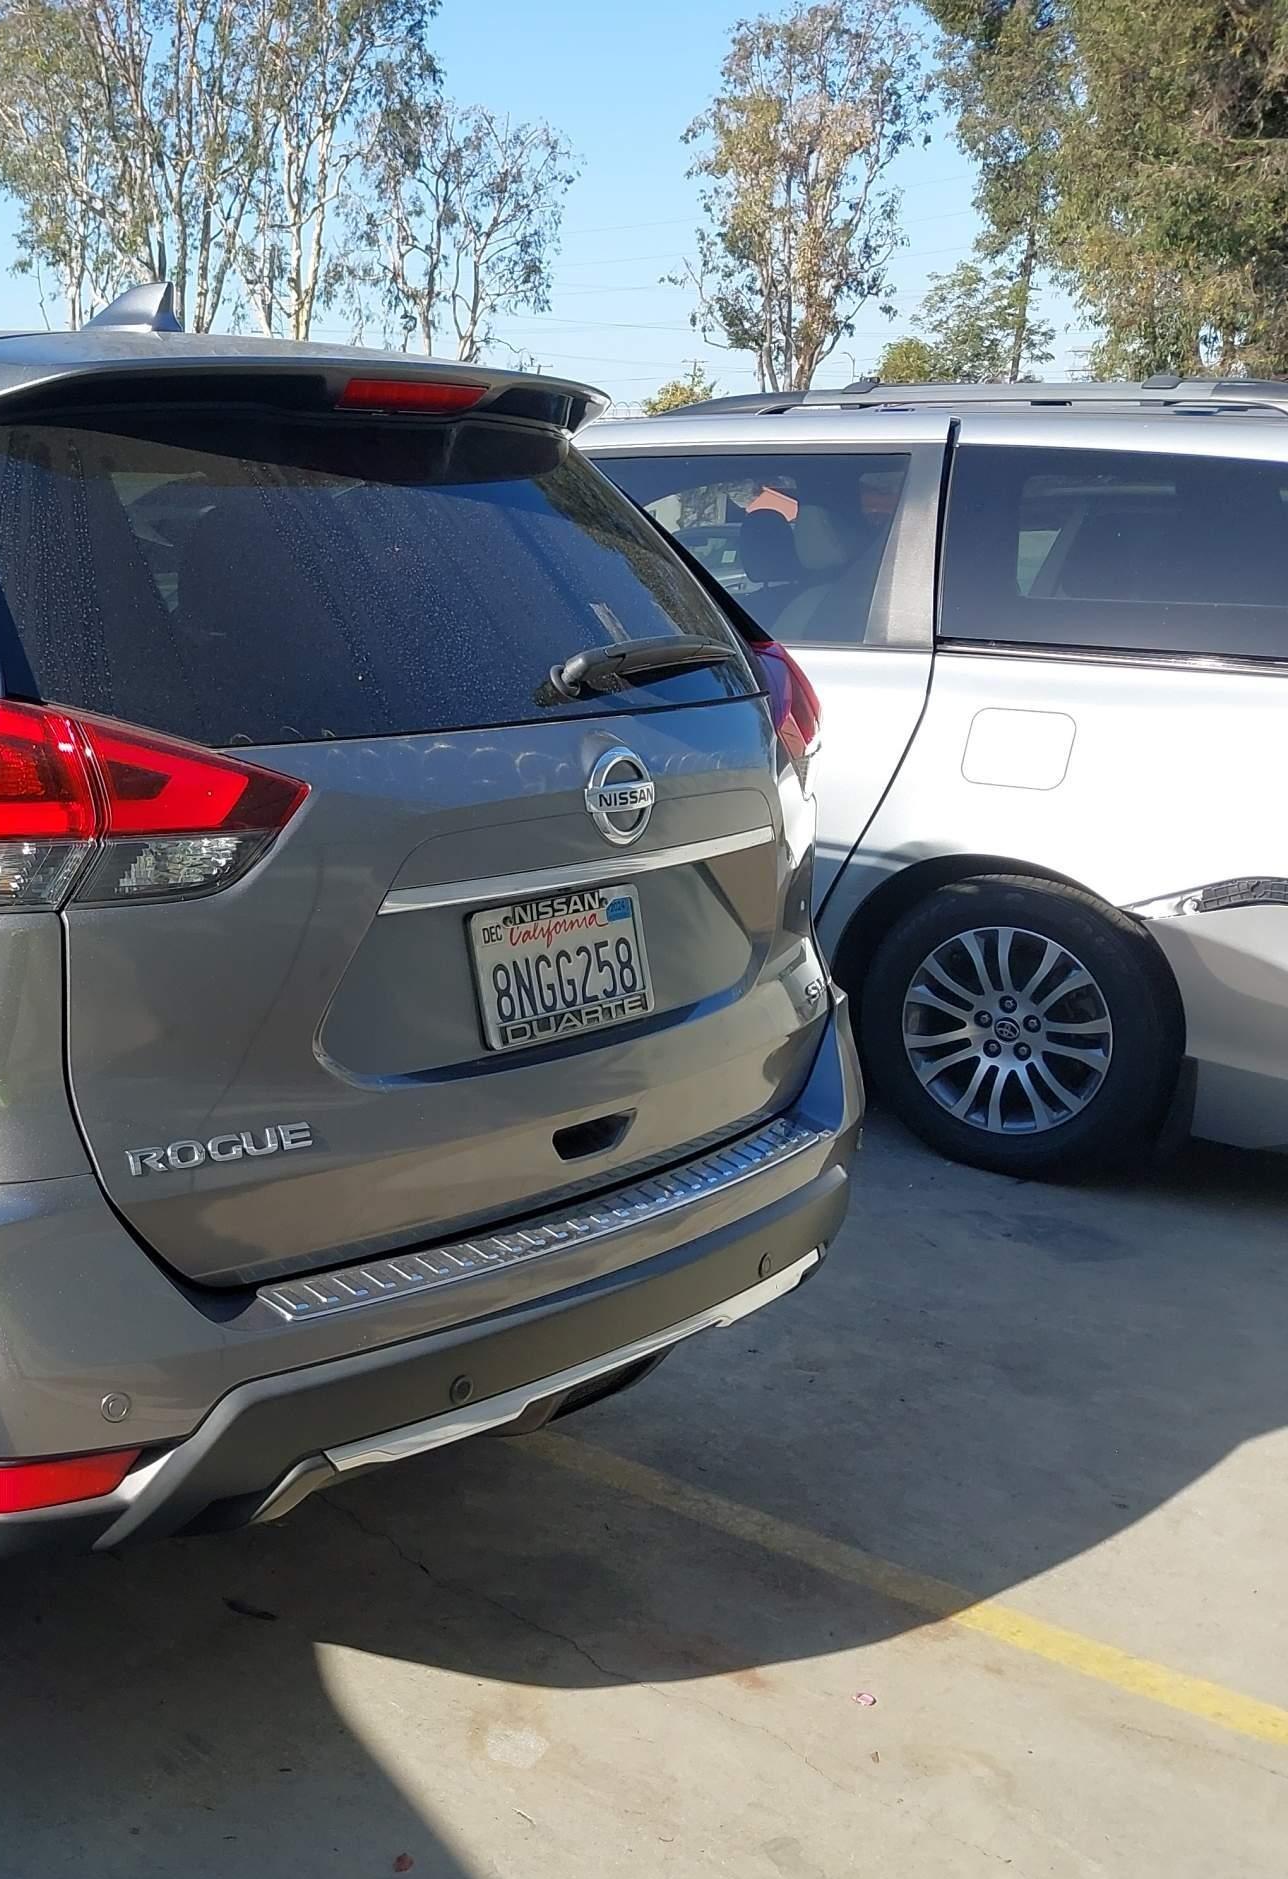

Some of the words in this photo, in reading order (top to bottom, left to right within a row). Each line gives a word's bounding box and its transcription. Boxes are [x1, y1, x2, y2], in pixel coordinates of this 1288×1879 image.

[598, 787, 652, 808] NISSAN
[513, 891, 601, 925] NISSAN
[482, 925, 503, 945] DEC
[508, 912, 609, 949] California
[492, 937, 638, 1023] 8NGG258
[506, 995, 649, 1044] DUARTE
[125, 1121, 313, 1176] ROGUE
